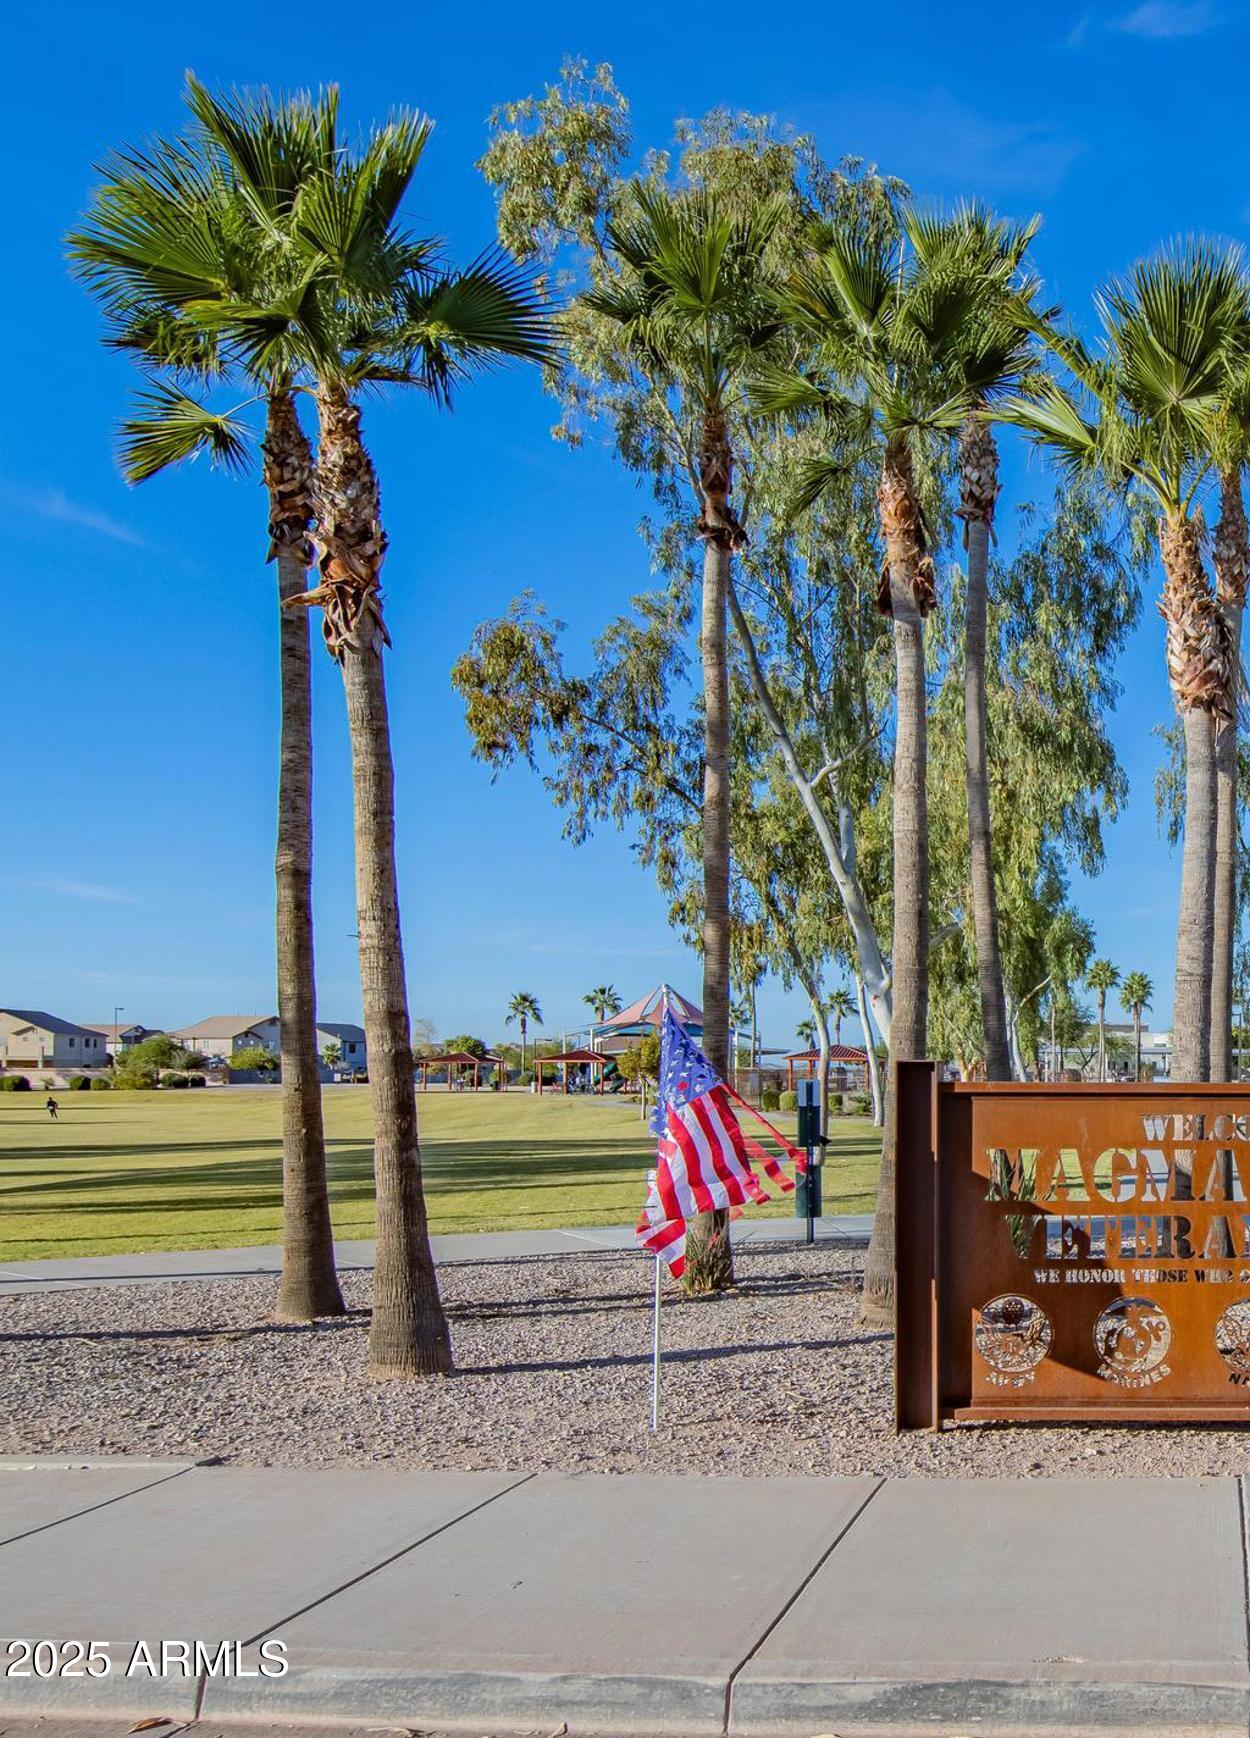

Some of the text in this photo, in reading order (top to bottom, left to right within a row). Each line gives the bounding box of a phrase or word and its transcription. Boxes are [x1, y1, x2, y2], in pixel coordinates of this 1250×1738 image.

[985, 1148, 1248, 1203] MAGMA
[1034, 1269, 1061, 1284] WE
[1065, 1268, 1126, 1284] HONOR
[1131, 1269, 1188, 1284] THOSE
[1097, 1364, 1172, 1389] MARINES
